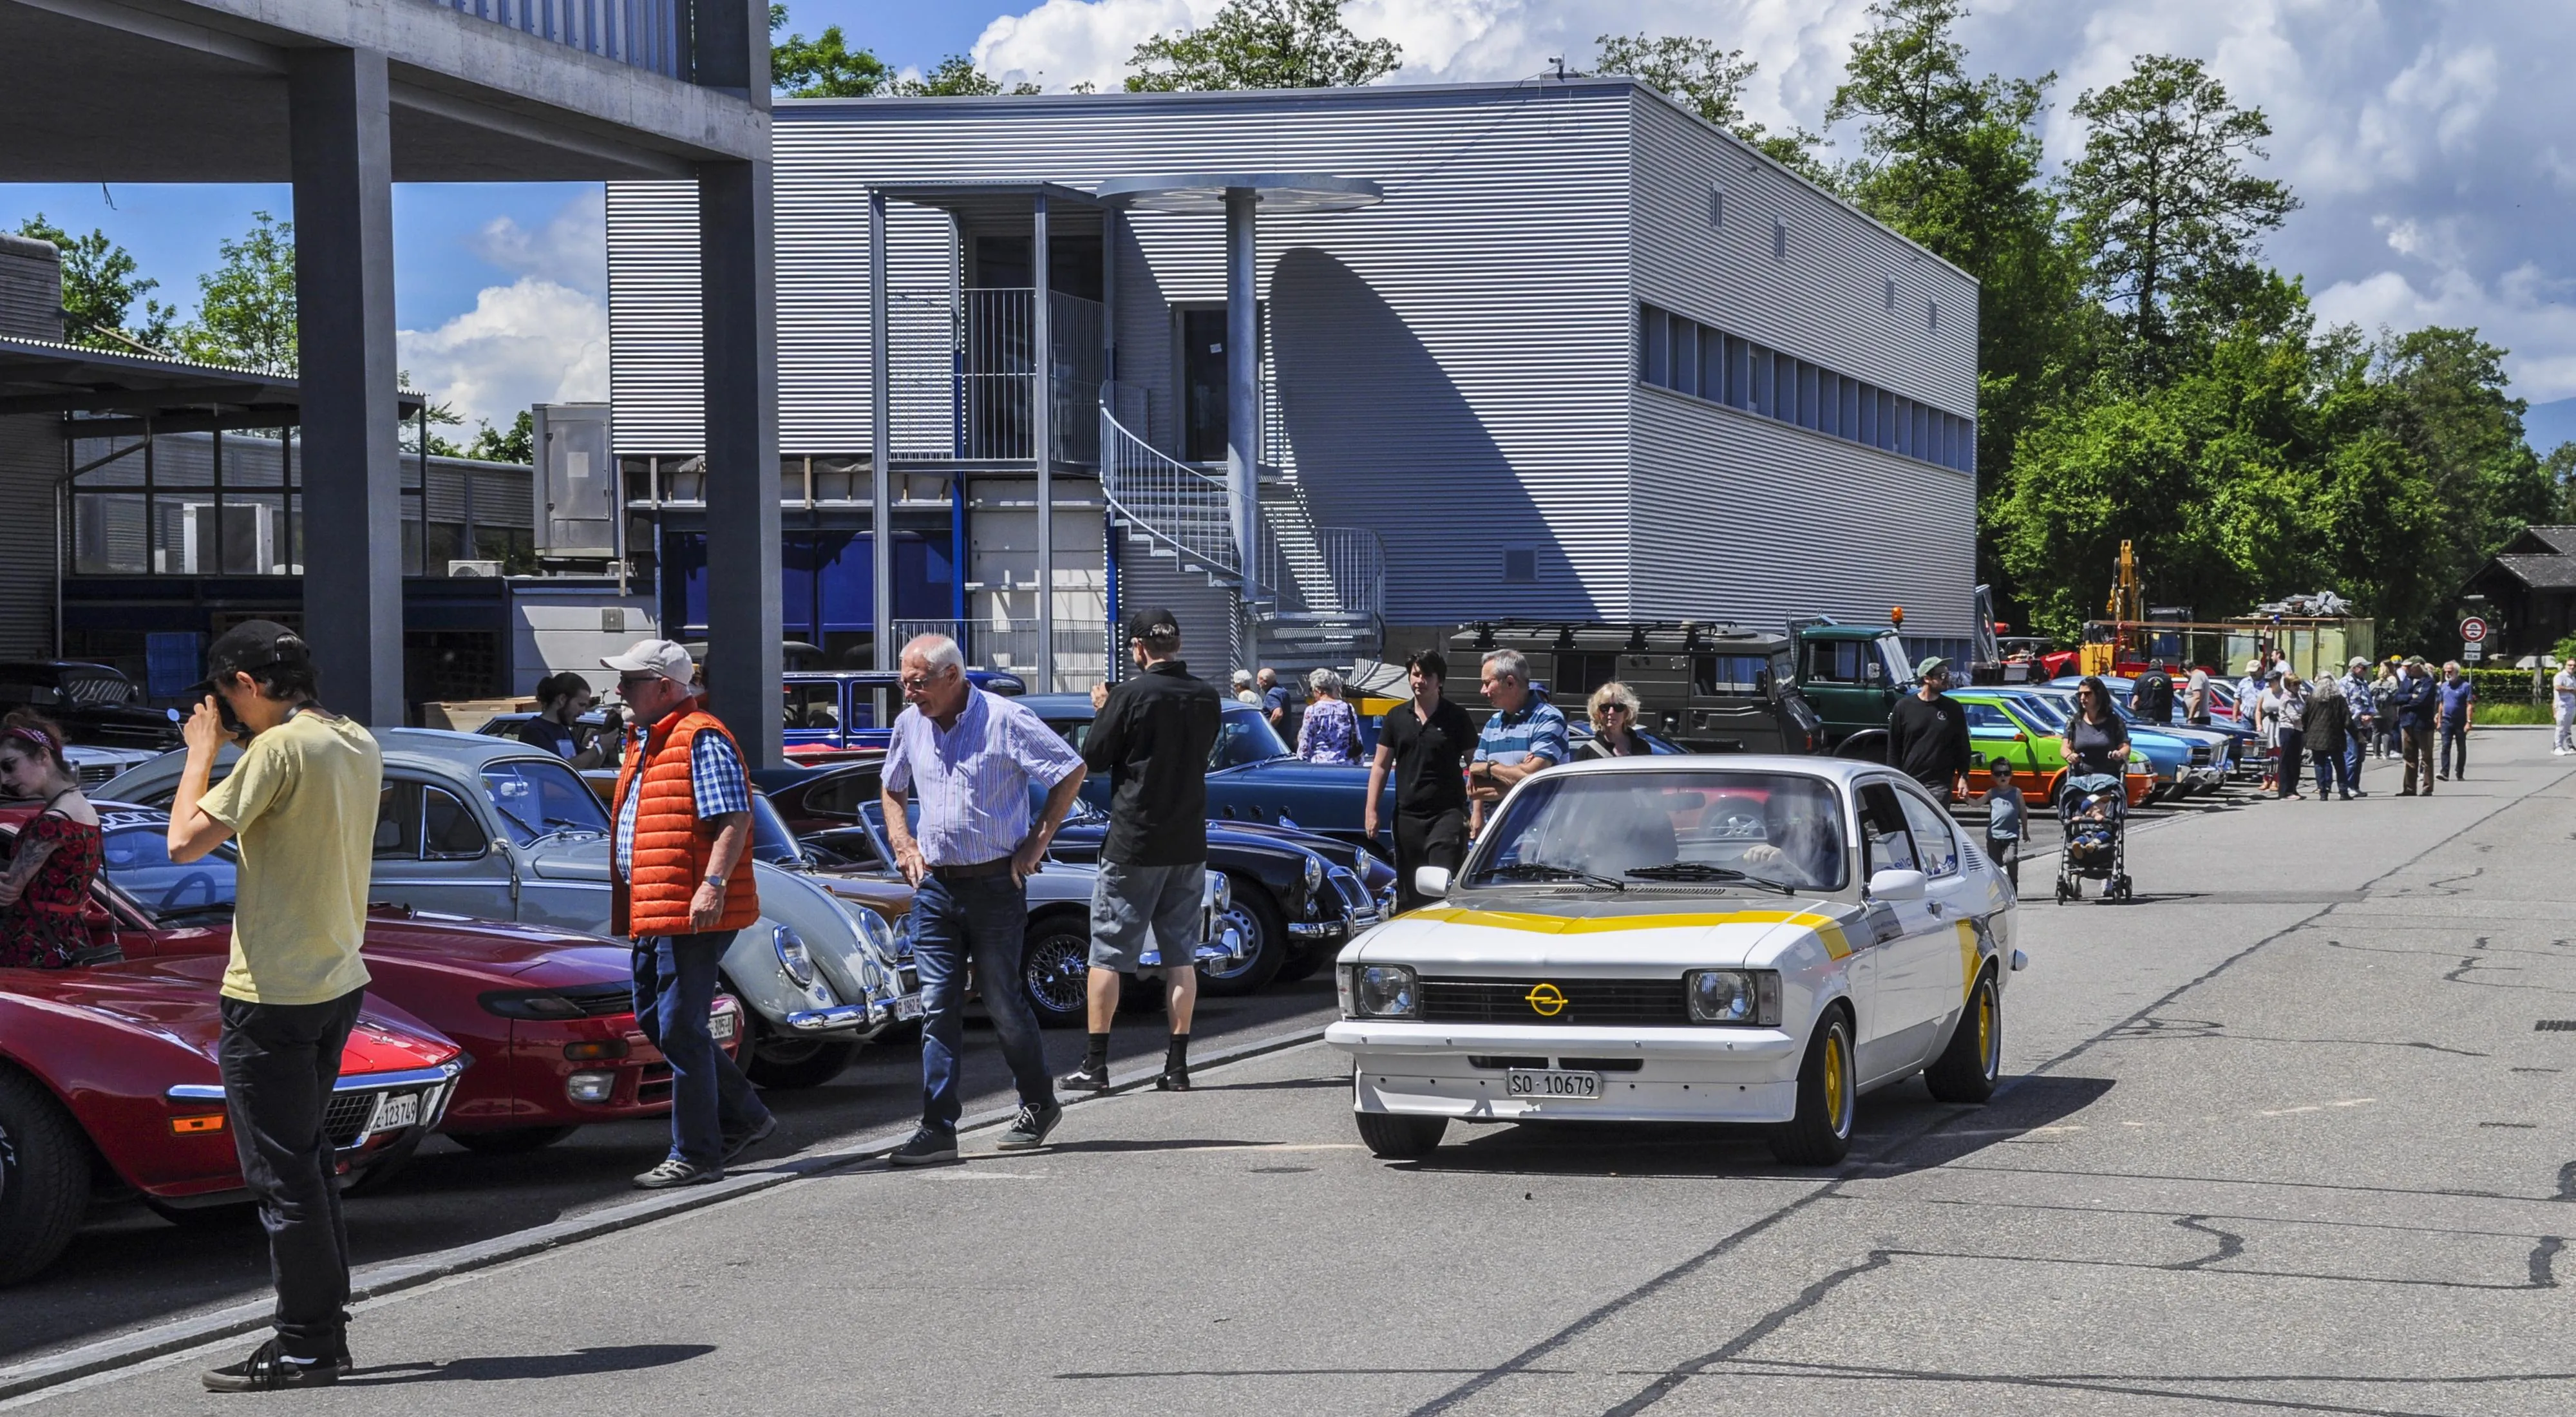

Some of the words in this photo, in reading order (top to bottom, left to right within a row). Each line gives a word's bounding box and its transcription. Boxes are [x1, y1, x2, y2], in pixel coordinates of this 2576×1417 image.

[1513, 1075, 1532, 1093] SO
[1544, 1076, 1595, 1095] 10679
[384, 1101, 416, 1127] 123749
